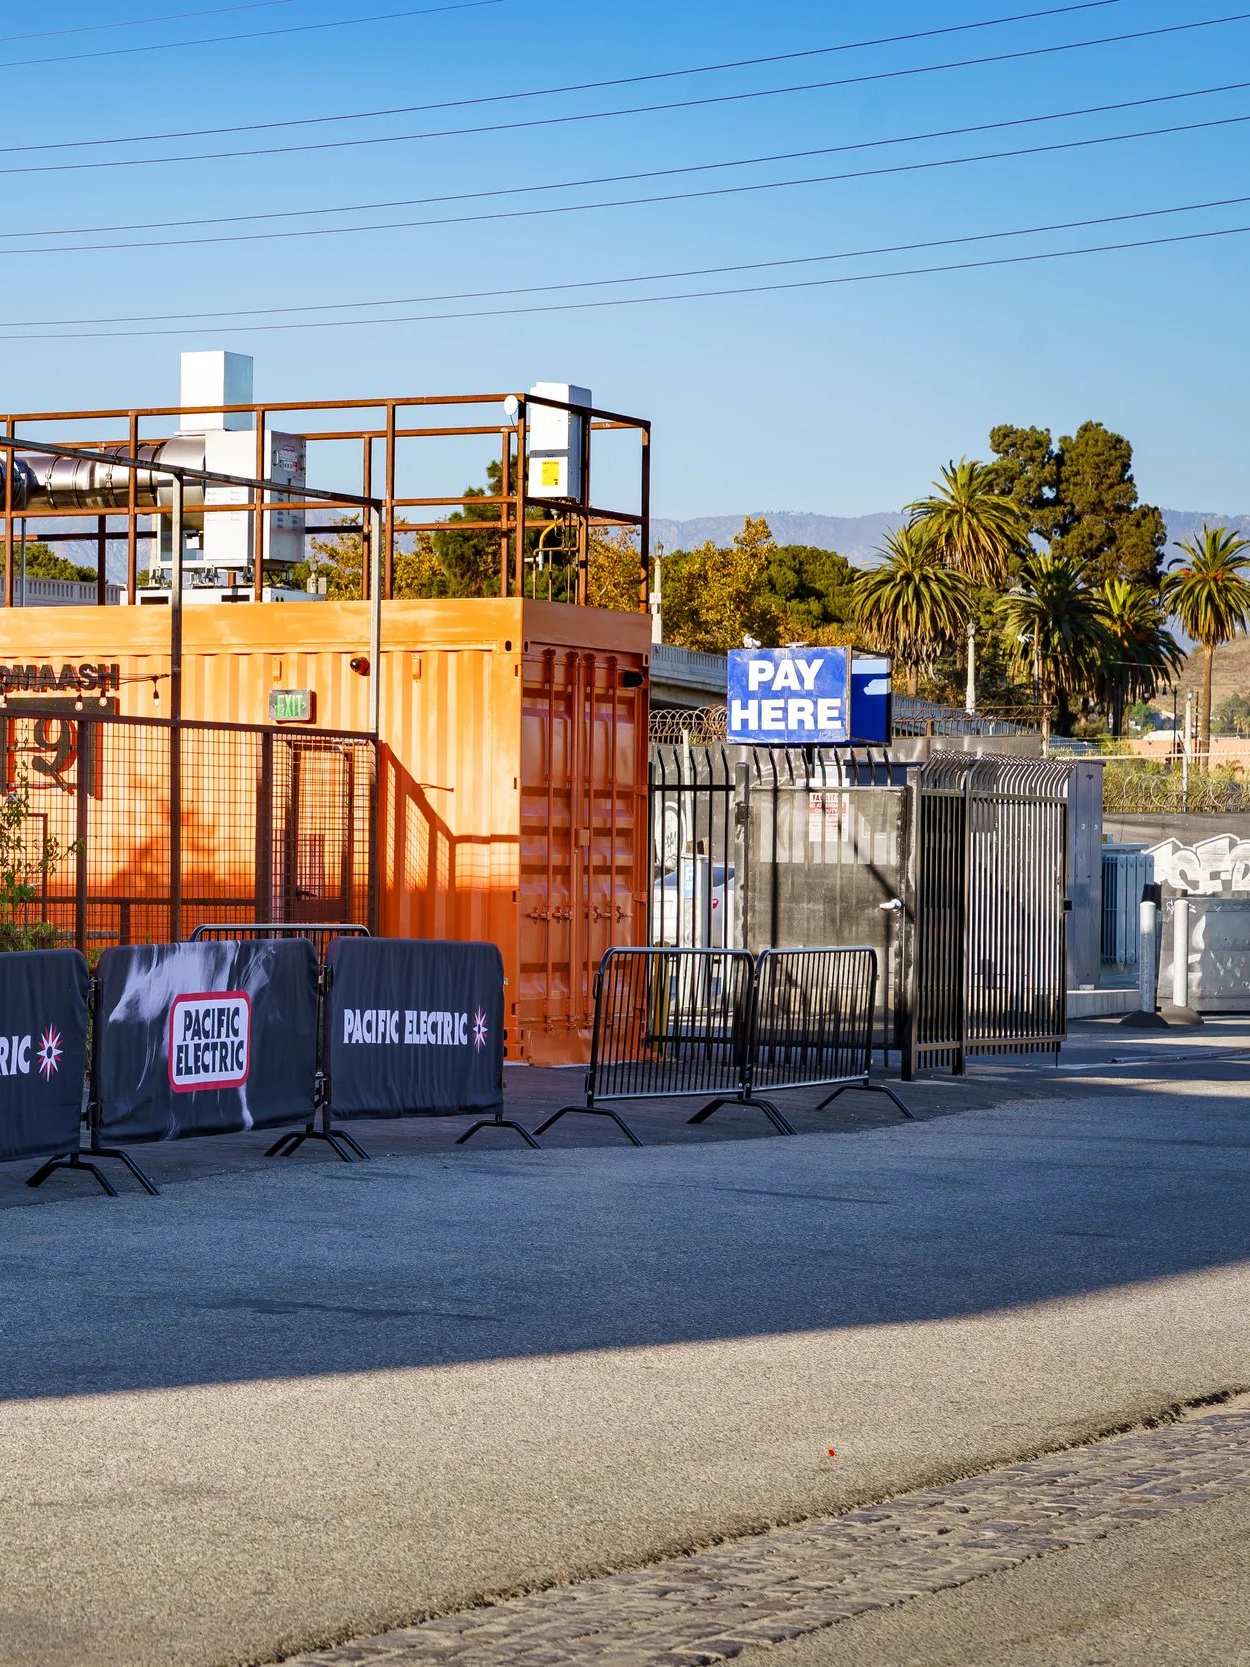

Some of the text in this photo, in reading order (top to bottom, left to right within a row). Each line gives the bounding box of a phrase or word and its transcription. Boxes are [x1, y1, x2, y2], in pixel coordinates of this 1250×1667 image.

[748, 658, 824, 691] PAY
[276, 694, 303, 717] EXIT
[731, 698, 842, 731] HERE
[182, 1007, 240, 1042] PACIFIC
[343, 1008, 468, 1045] PACIFIC ELECTRIC
[175, 1040, 244, 1076] ELECTRIC
